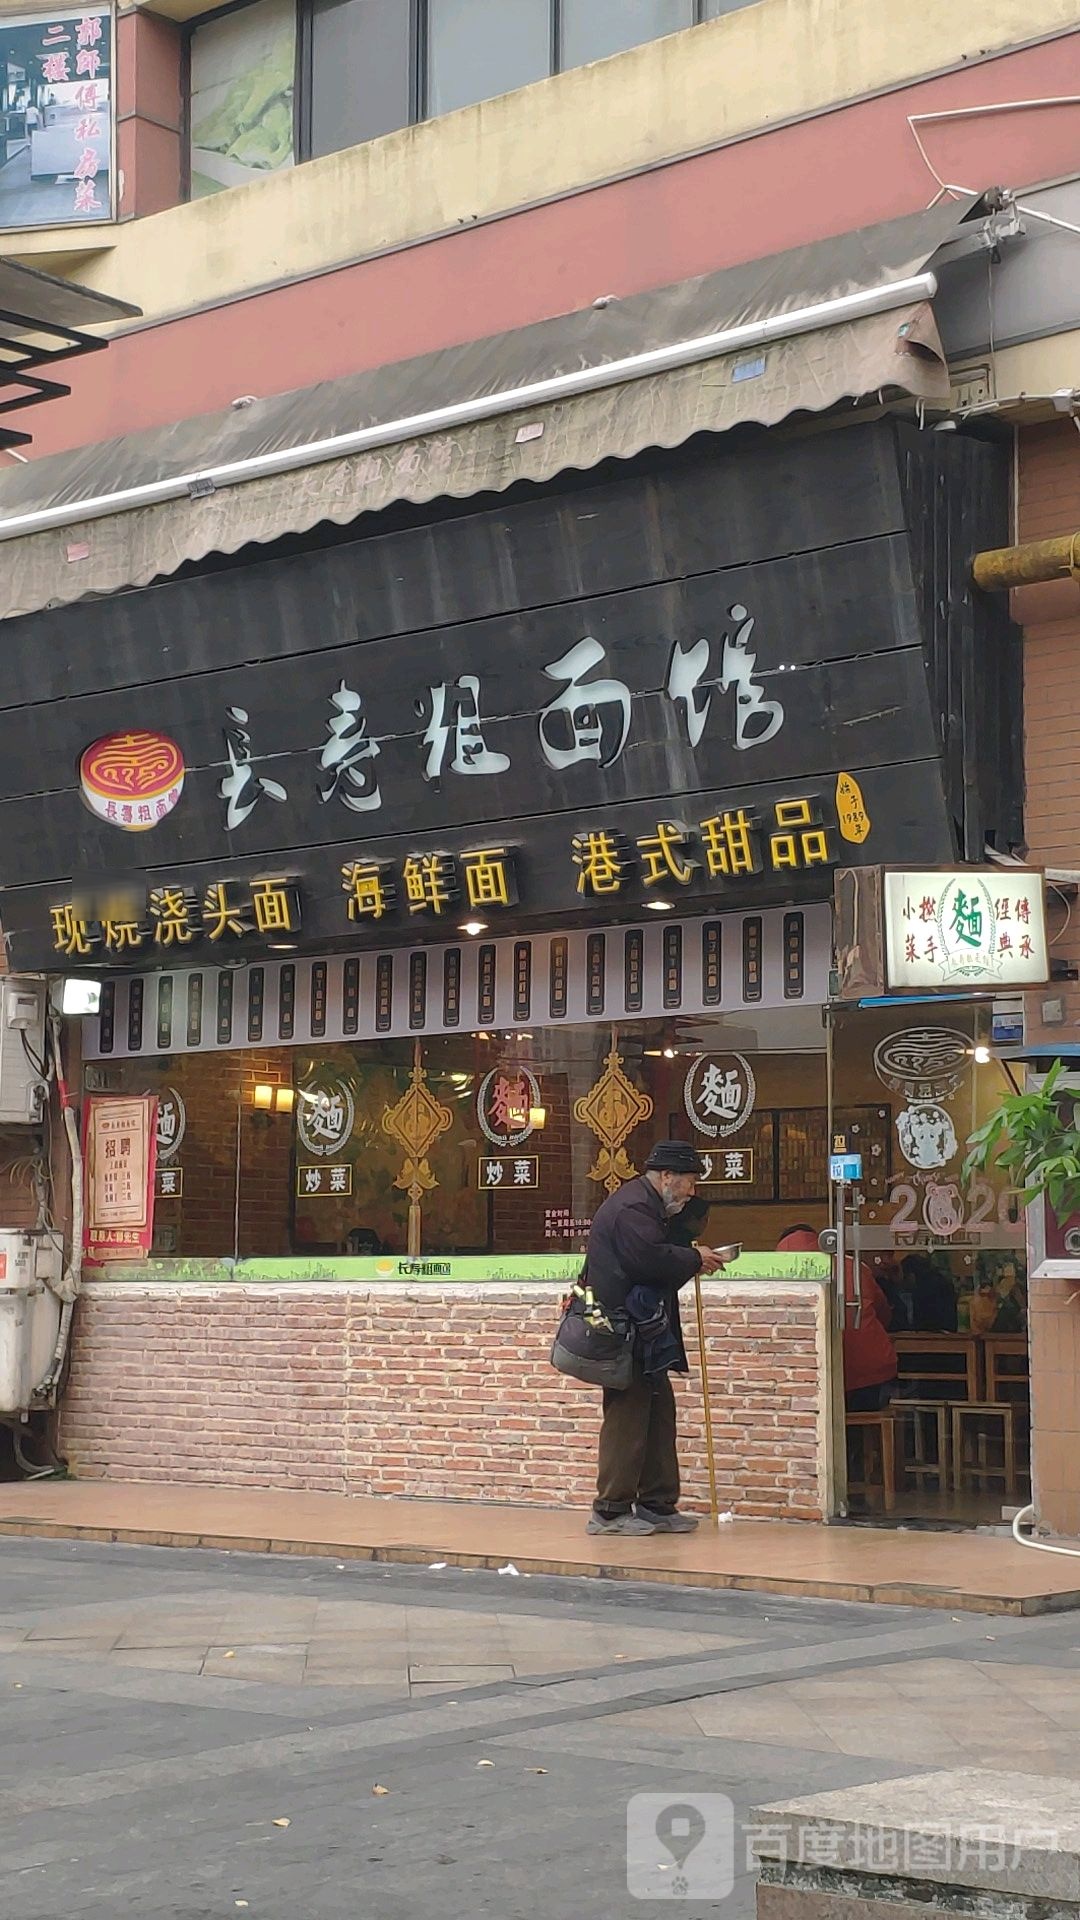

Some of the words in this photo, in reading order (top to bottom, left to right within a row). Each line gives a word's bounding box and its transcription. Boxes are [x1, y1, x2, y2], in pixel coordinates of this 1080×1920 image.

[341, 848, 509, 921] 海鲜面
[571, 799, 830, 895] 港式甜品
[305, 1167, 346, 1193] 炒菜
[486, 1159, 532, 1185] 炒菜
